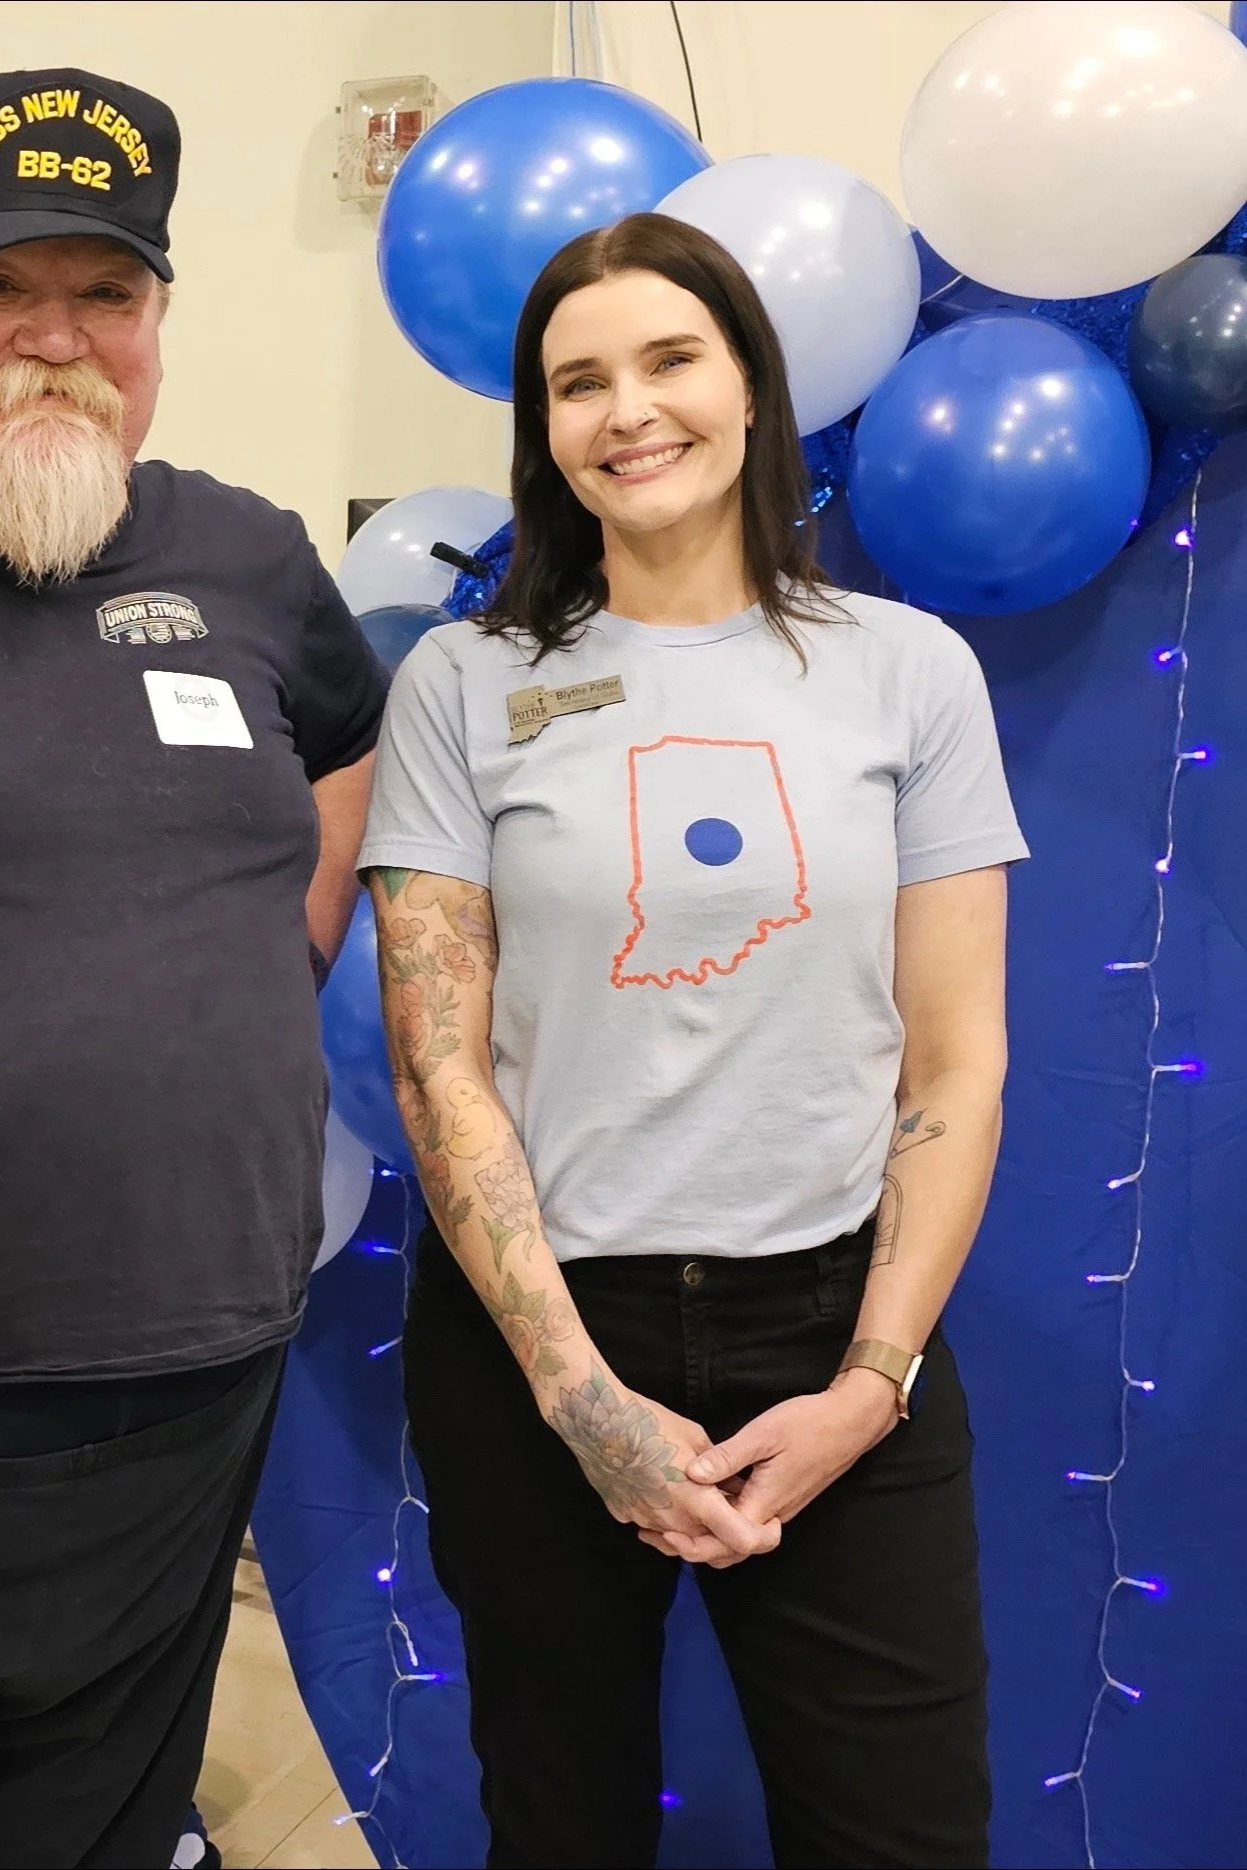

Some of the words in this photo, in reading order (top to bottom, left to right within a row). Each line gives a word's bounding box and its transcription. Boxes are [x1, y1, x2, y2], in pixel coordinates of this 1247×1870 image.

[21, 89, 81, 123] NEW
[82, 99, 152, 178] JERSEY
[17, 150, 111, 191] BB-62
[105, 603, 147, 627] UNION
[148, 602, 198, 623] STRONG
[556, 687, 588, 700] Blythe
[589, 680, 618, 692] Potter
[513, 706, 548, 722] POTTER
